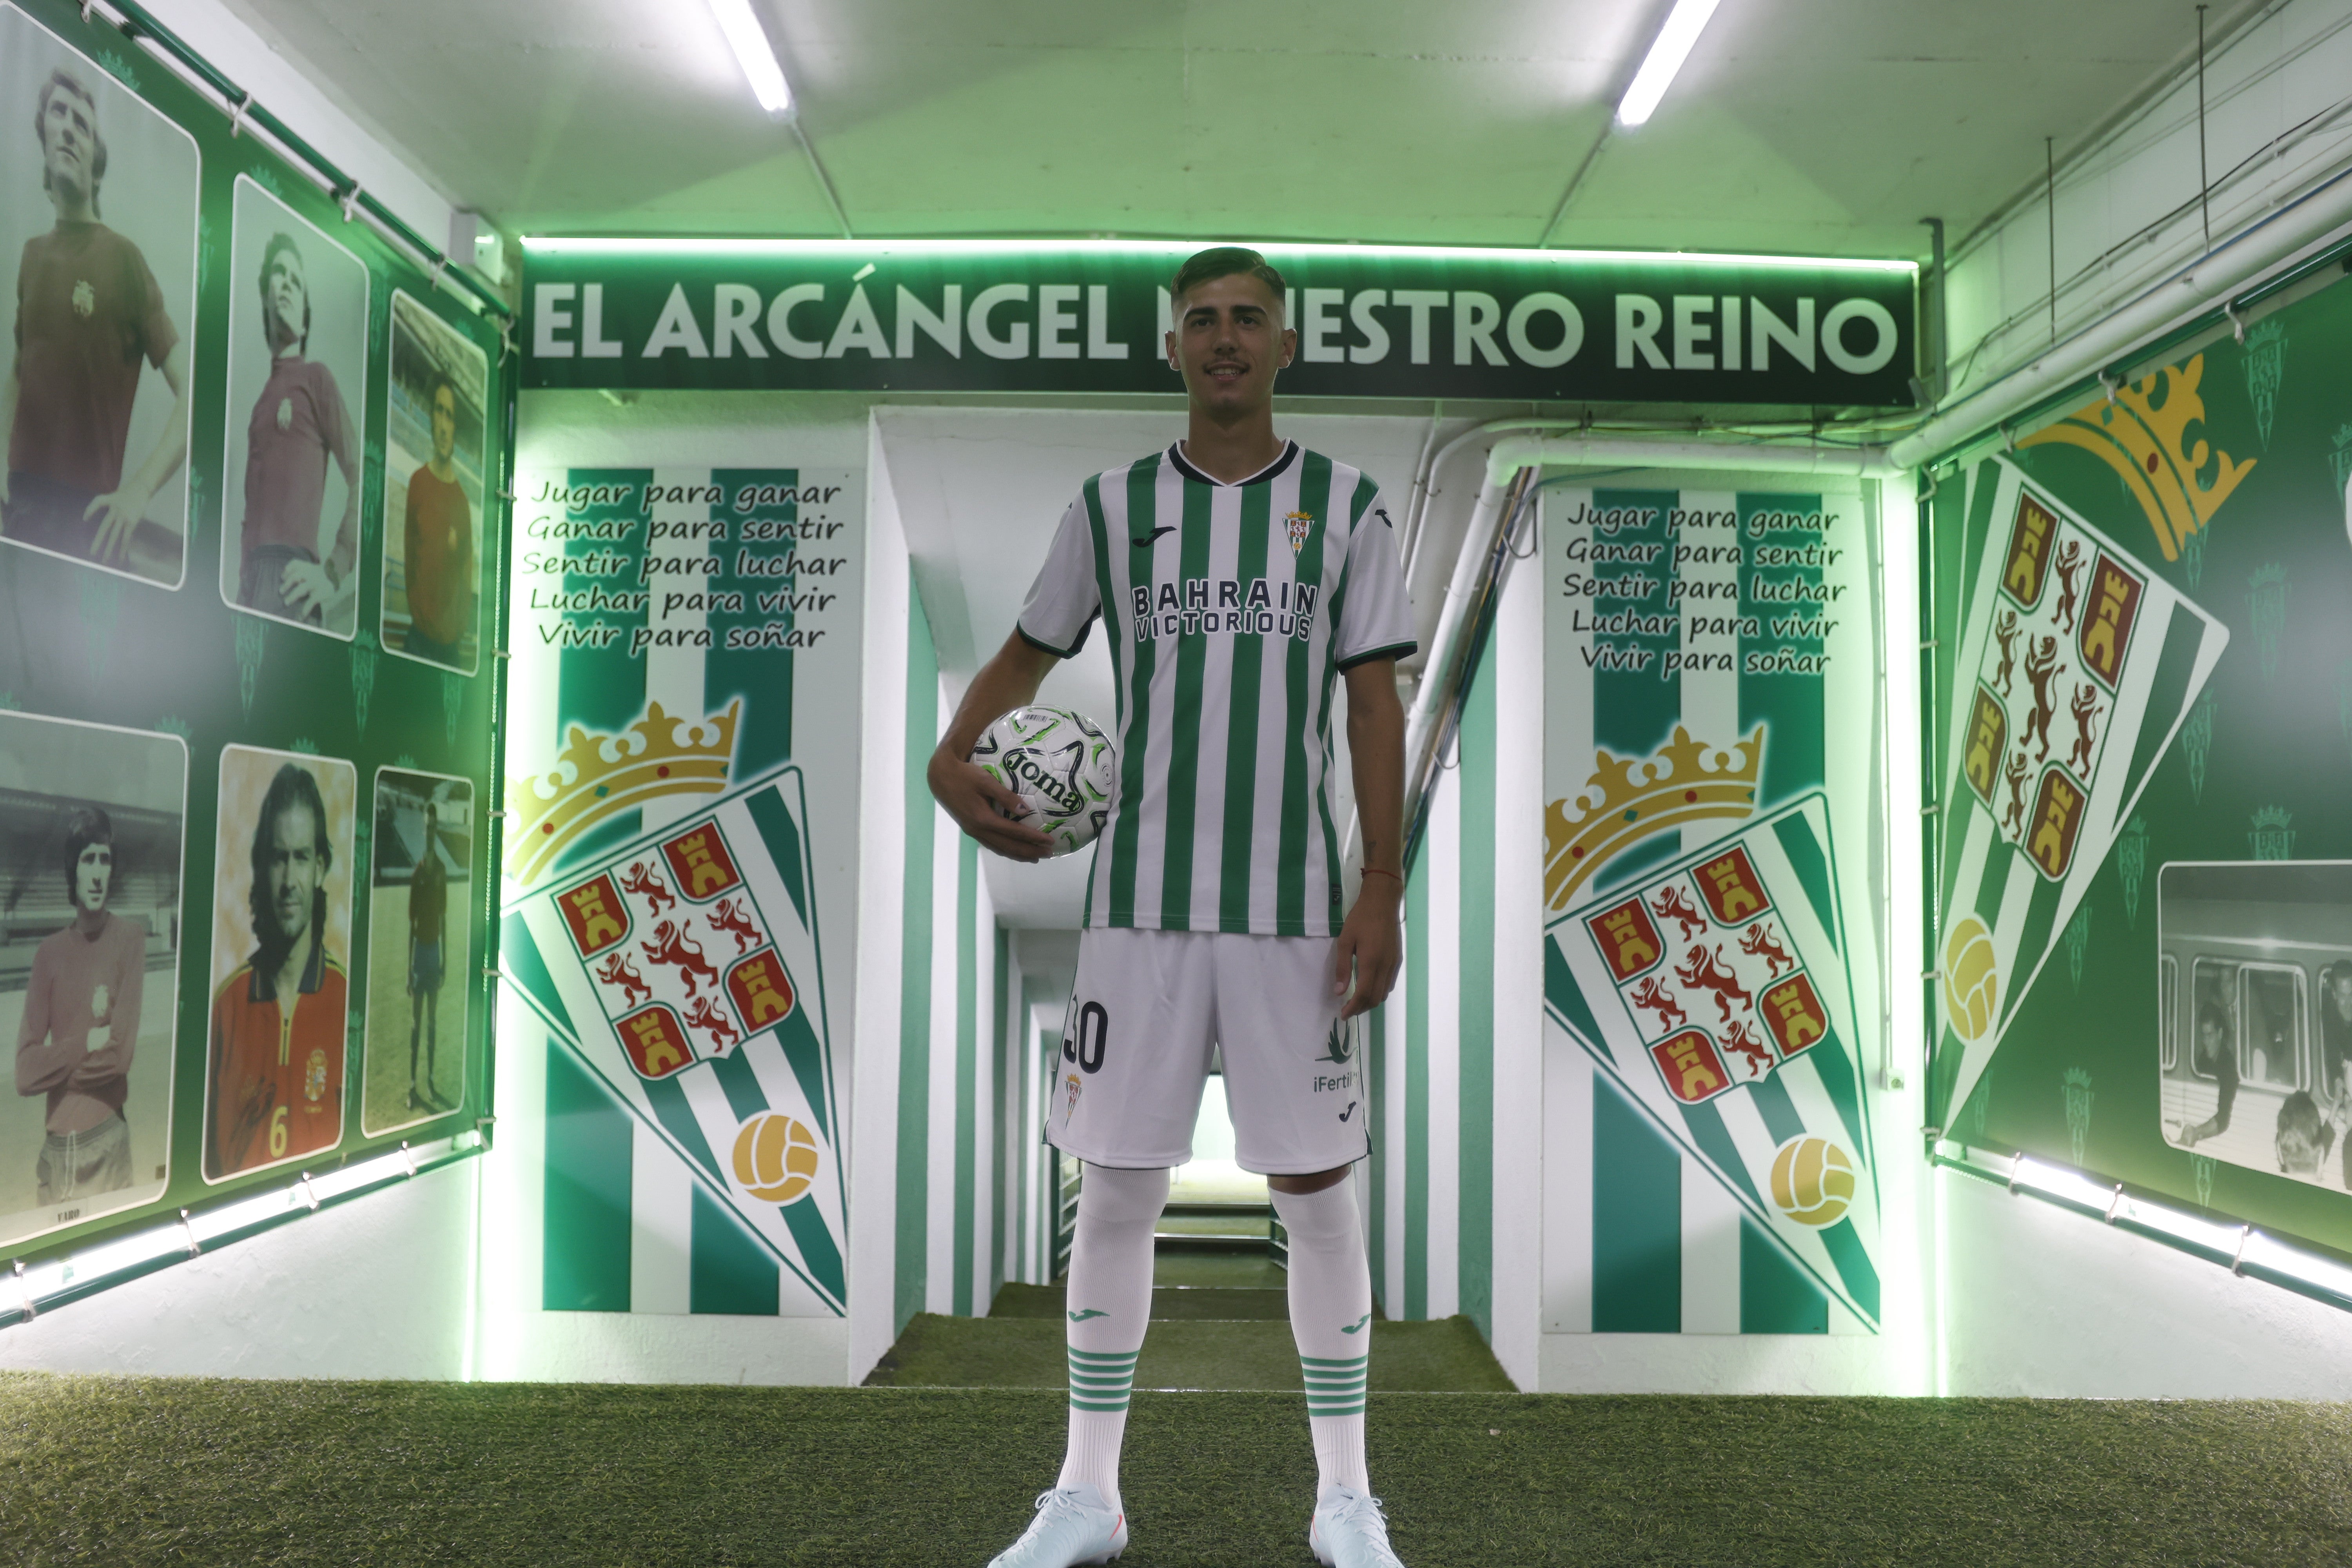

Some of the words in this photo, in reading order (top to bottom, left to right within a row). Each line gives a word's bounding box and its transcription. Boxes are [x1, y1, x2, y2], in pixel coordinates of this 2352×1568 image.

[534, 283, 622, 358] EL
[641, 263, 1129, 359] ARCÁNGEL
[1157, 285, 1584, 368] ESTRO
[1615, 293, 1898, 375] REINO
[531, 482, 631, 510] Jugar
[642, 485, 722, 512] para
[736, 485, 841, 511] ganar
[528, 516, 634, 539] Ganar
[646, 520, 727, 548] para
[741, 516, 844, 539] sentir
[1568, 503, 1657, 534] Jugar
[1667, 508, 1737, 535] para
[1749, 512, 1839, 537] ganar
[523, 550, 628, 574] Sentir
[639, 555, 720, 583] para
[738, 550, 846, 575] luchar
[1567, 538, 1662, 563] Ganar
[1672, 543, 1742, 572] para
[1755, 543, 1843, 566] sentir
[531, 586, 650, 610] Luchar
[663, 591, 742, 619] para
[759, 588, 836, 612] vivir
[1132, 579, 1317, 618] BAHRAIN
[1563, 573, 1658, 596] Sentir
[1668, 579, 1738, 607] para
[1753, 576, 1847, 602] luchar
[539, 622, 620, 644] Vivir
[630, 627, 711, 655] para
[727, 624, 825, 648] soñar
[1136, 610, 1310, 642] VICTORIOUS
[1573, 610, 1678, 634] Luchar
[1690, 615, 1759, 643] para
[1773, 613, 1839, 638] vivir
[1581, 645, 1652, 668] Vivir
[1663, 650, 1733, 679] para
[1747, 649, 1831, 673] soñar
[1007, 752, 1081, 812] Joma
[270, 1105, 288, 1158] 6
